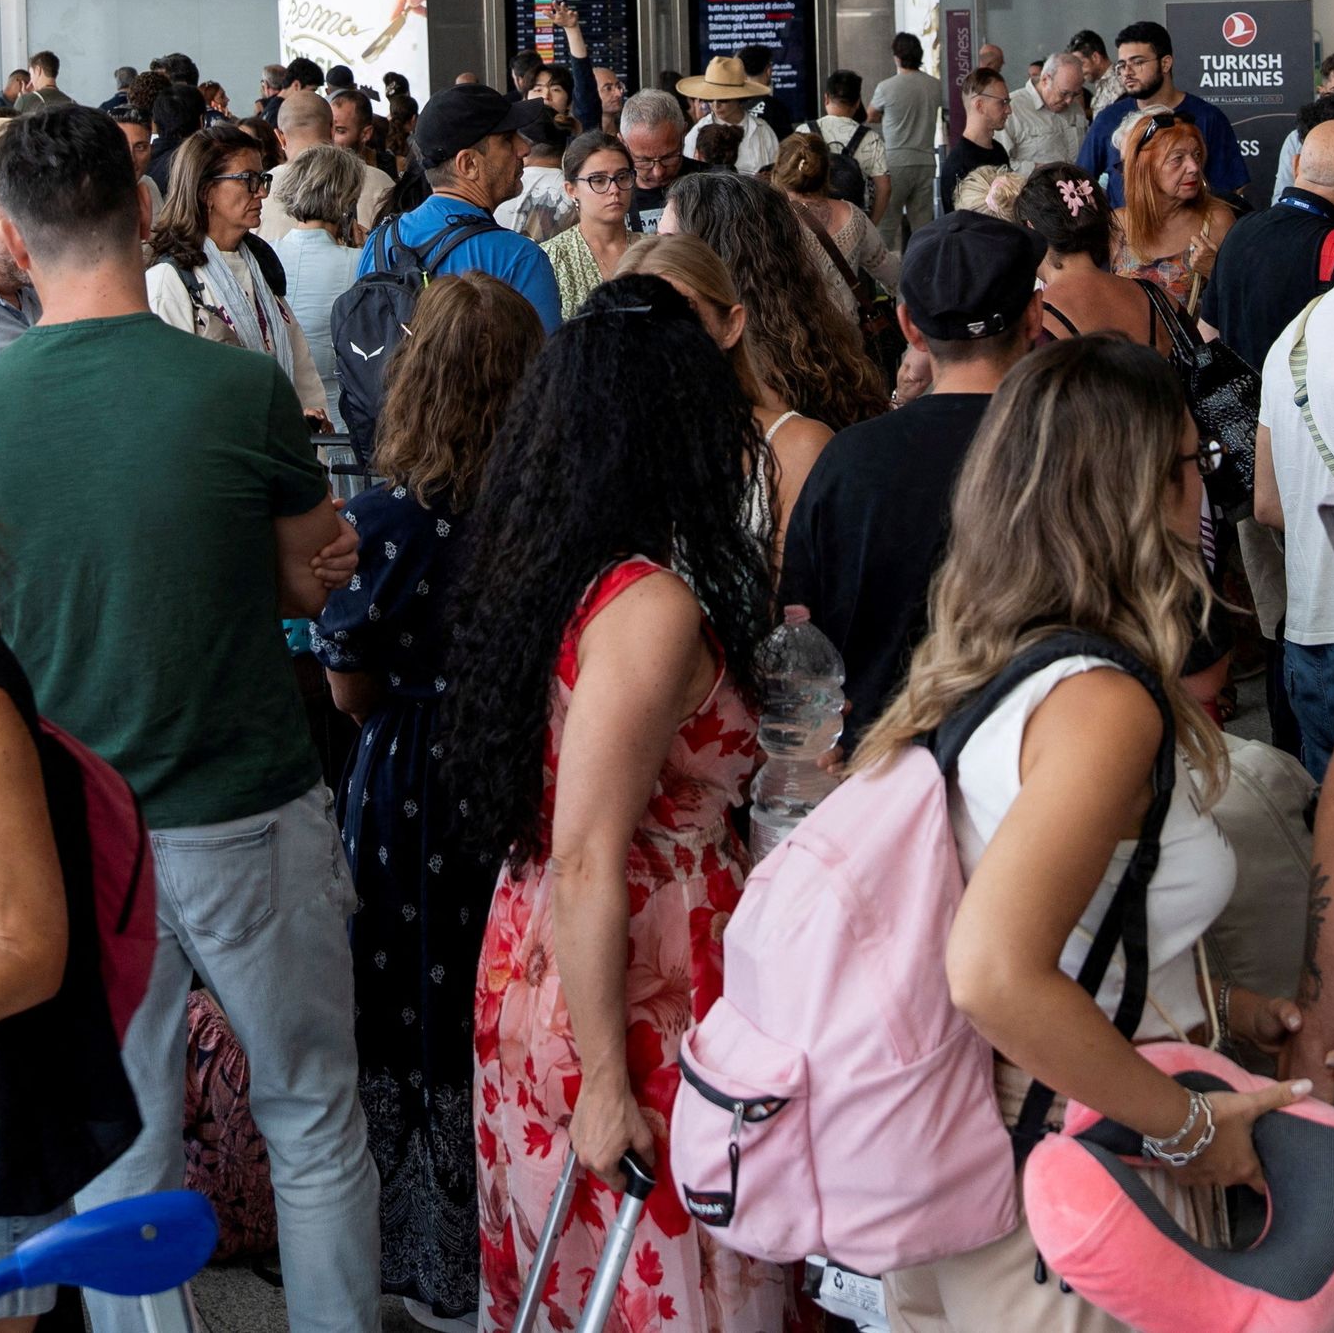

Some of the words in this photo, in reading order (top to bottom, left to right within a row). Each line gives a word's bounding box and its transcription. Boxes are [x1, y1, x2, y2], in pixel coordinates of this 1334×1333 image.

[731, 3, 764, 12] operazioni
[772, 2, 795, 10] decollo
[714, 14, 748, 23] atterraggio
[709, 23, 732, 31] Stiamo
[775, 22, 786, 30] per
[709, 32, 742, 40] consentire
[756, 31, 776, 40] rapida
[709, 43, 731, 51] ripresa
[1200, 54, 1282, 70] TURKISH
[1200, 71, 1284, 87] AIRLINES
